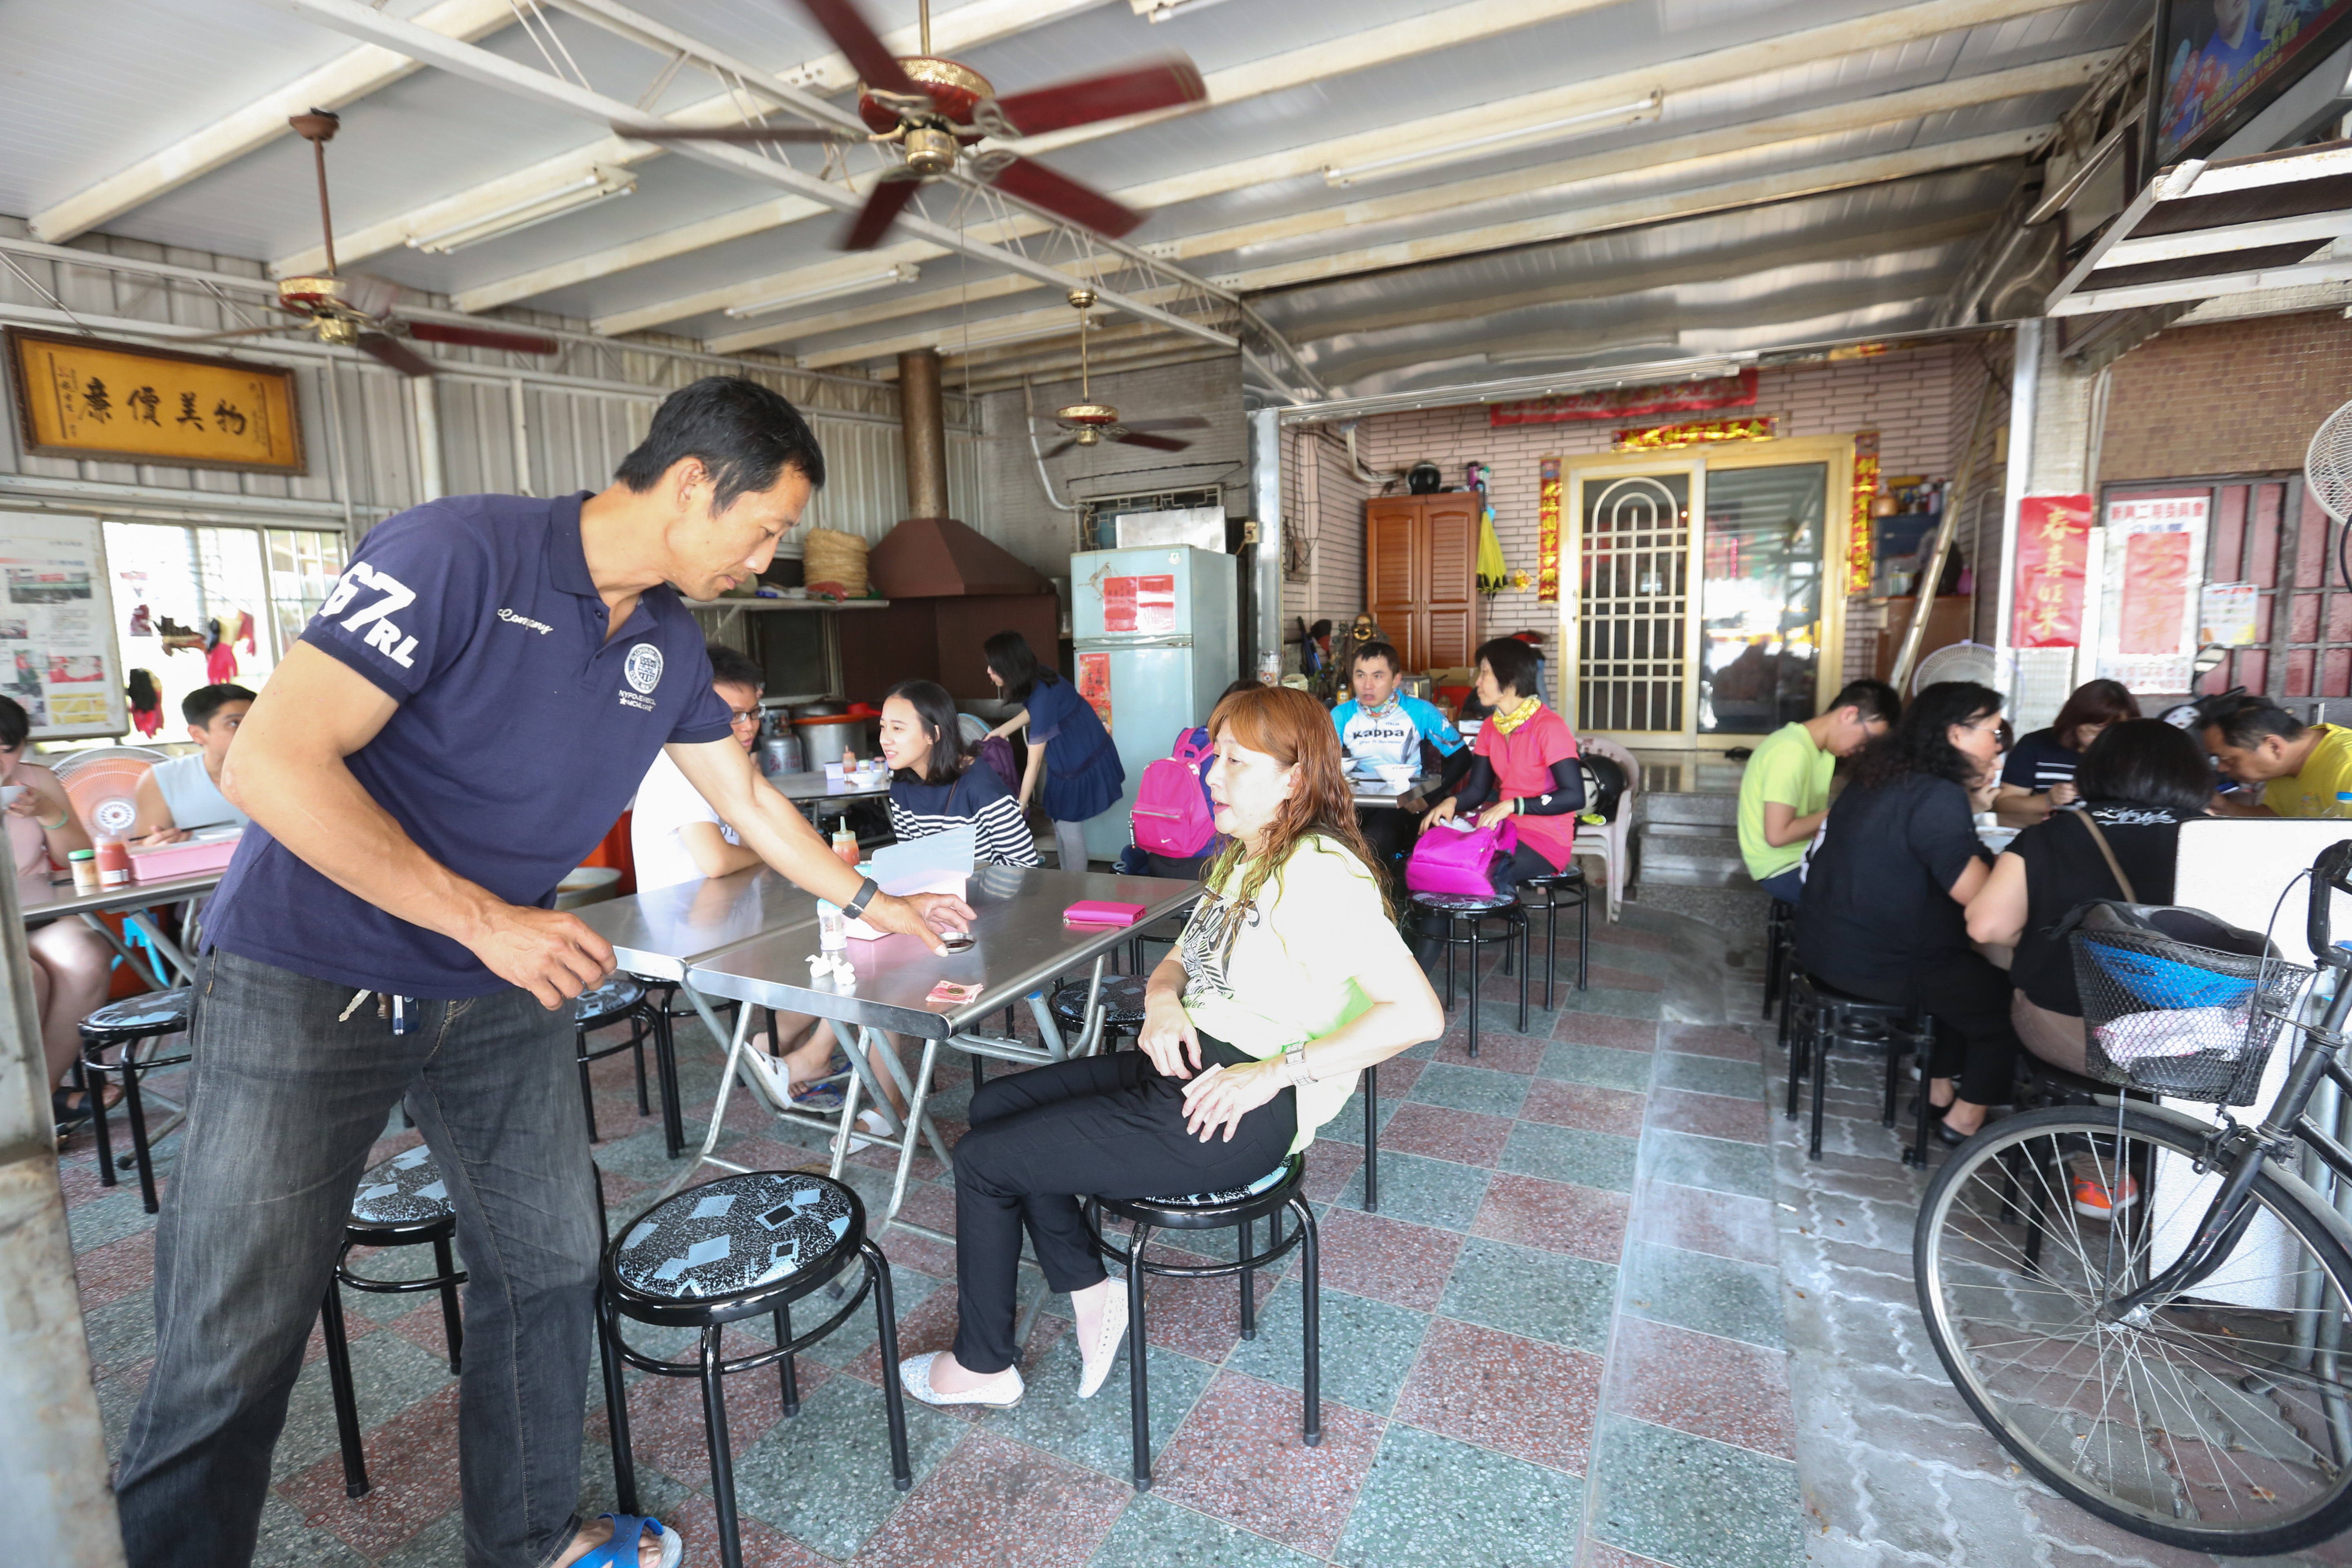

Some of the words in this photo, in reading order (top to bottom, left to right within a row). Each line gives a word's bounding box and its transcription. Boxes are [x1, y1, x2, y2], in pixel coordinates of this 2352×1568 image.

[78, 376, 247, 436] 物美價廉
[363, 616, 419, 669] RL
[497, 608, 554, 635] Company
